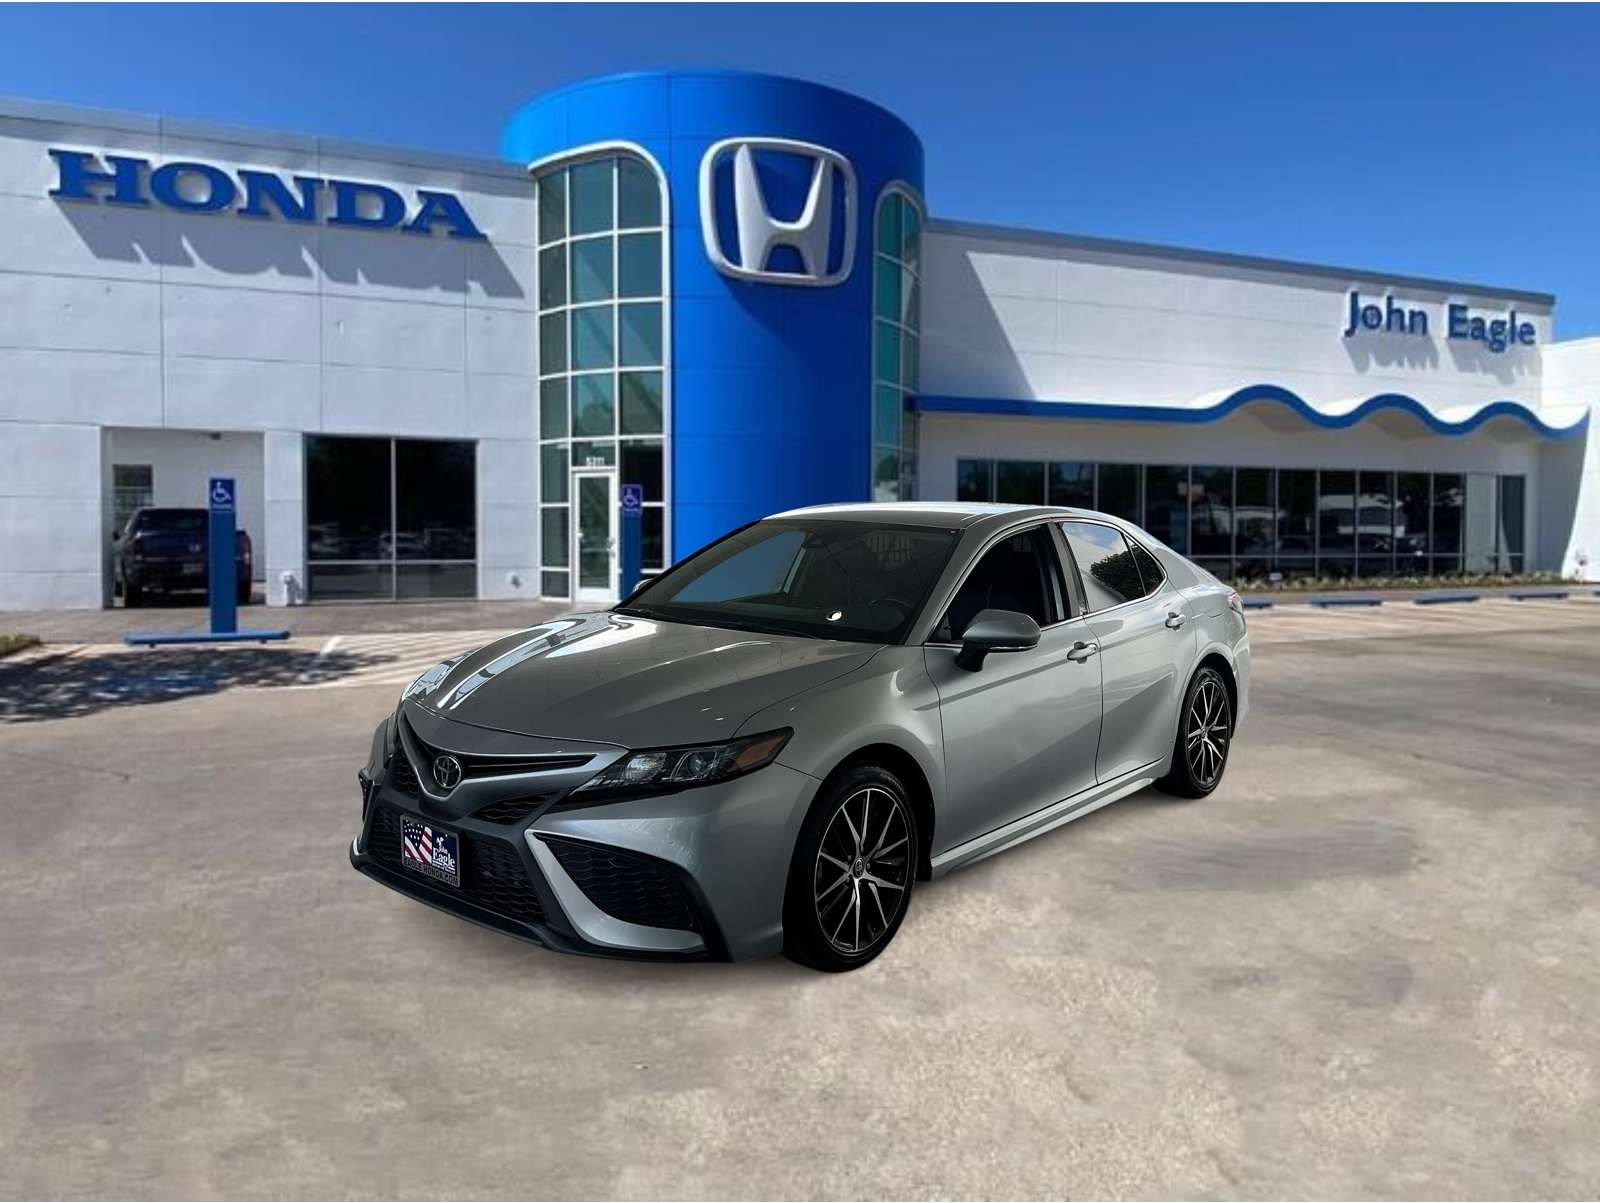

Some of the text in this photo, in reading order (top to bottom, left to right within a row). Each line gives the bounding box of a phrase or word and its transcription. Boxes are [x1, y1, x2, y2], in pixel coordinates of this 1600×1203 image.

[48, 149, 487, 240] HONDA
[1344, 291, 1536, 353] John Eagle
[432, 847, 456, 868] Eagle
